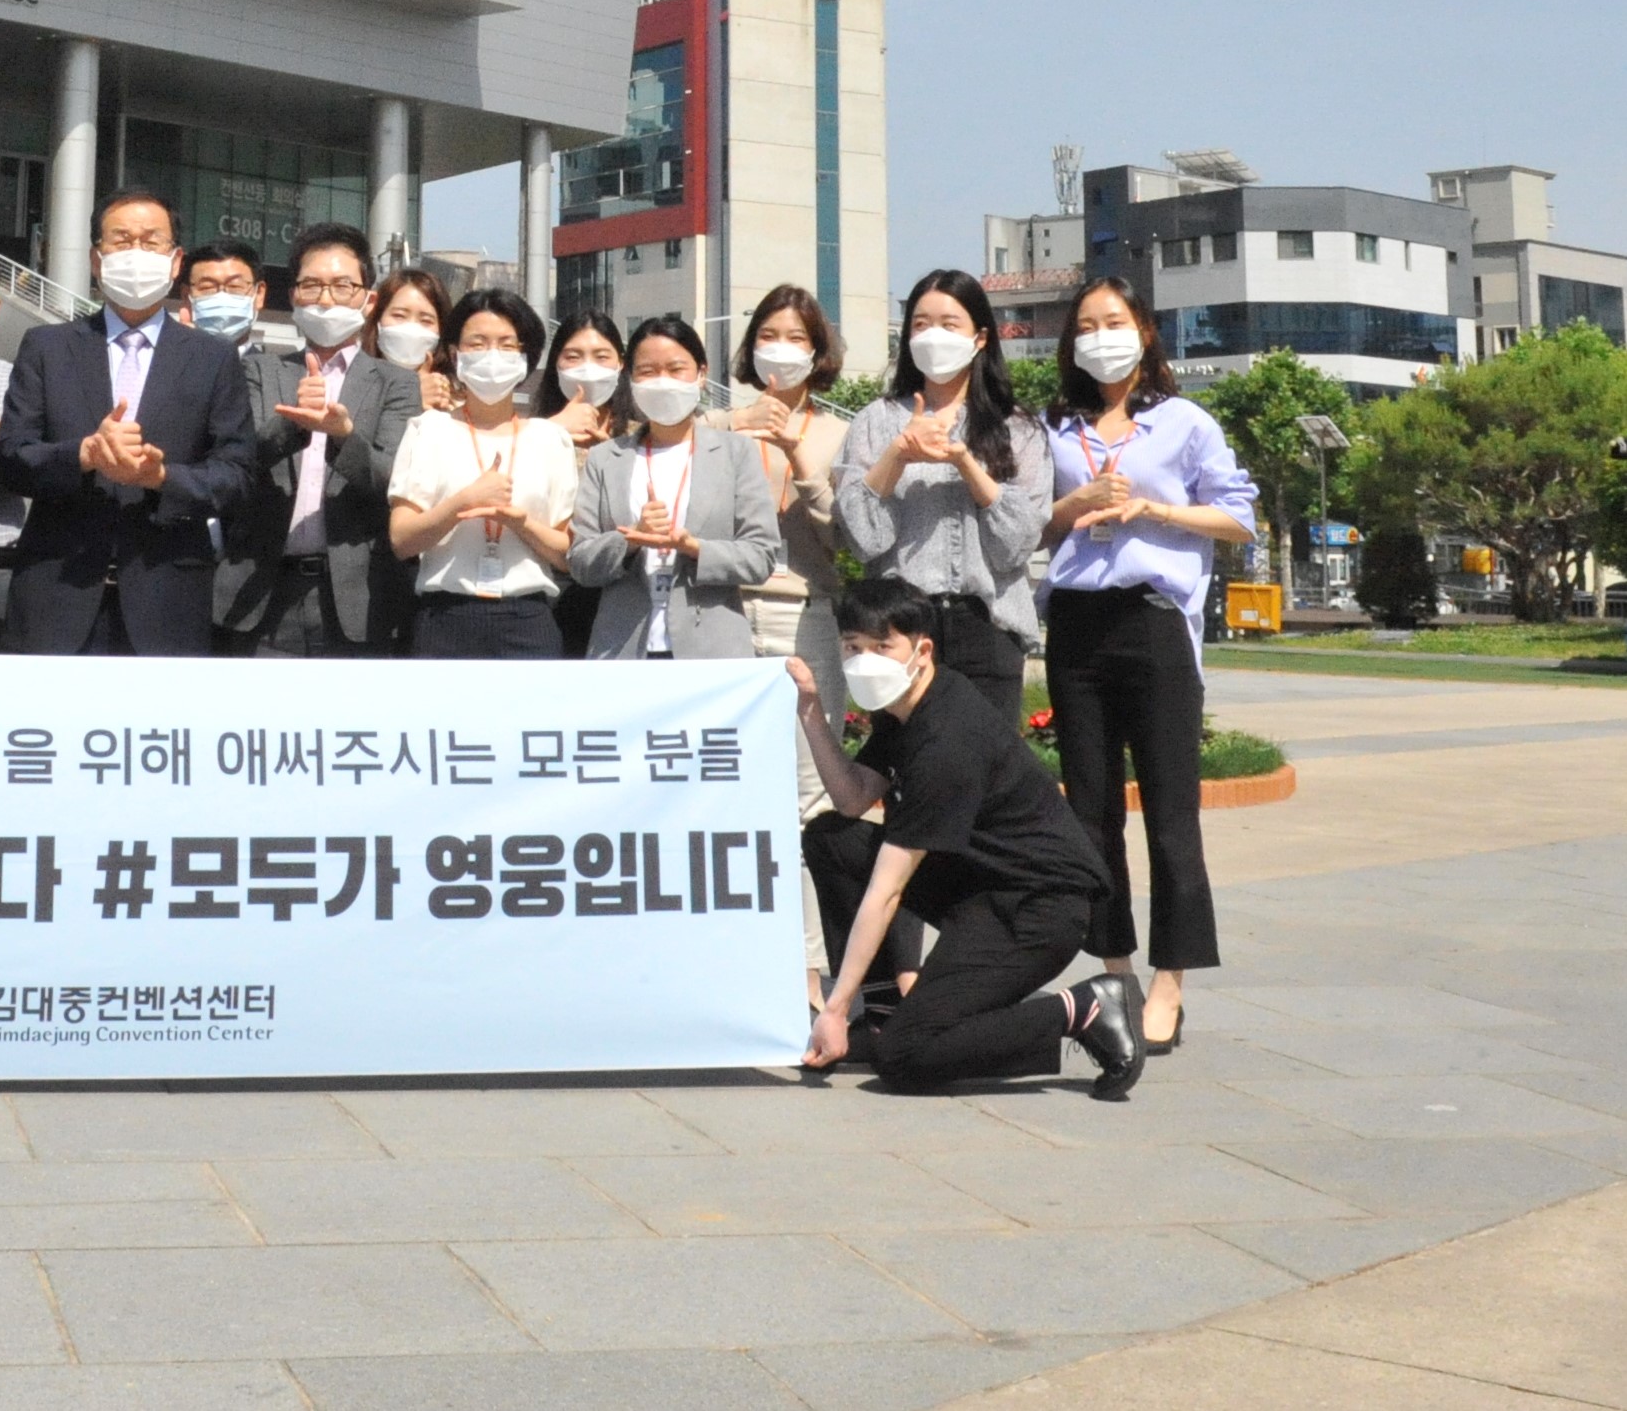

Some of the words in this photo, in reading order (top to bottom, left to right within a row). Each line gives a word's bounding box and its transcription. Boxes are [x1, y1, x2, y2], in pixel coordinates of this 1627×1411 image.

[218, 214, 262, 240] C308
[79, 728, 192, 786] 위해
[216, 728, 496, 786] 애써주시는
[518, 729, 621, 784] 모든
[644, 727, 742, 782] 분들
[93, 834, 400, 922] #모두가
[425, 830, 779, 919] 영웅입니다
[96, 1026, 202, 1042] Convention
[207, 1025, 274, 1041] Center
